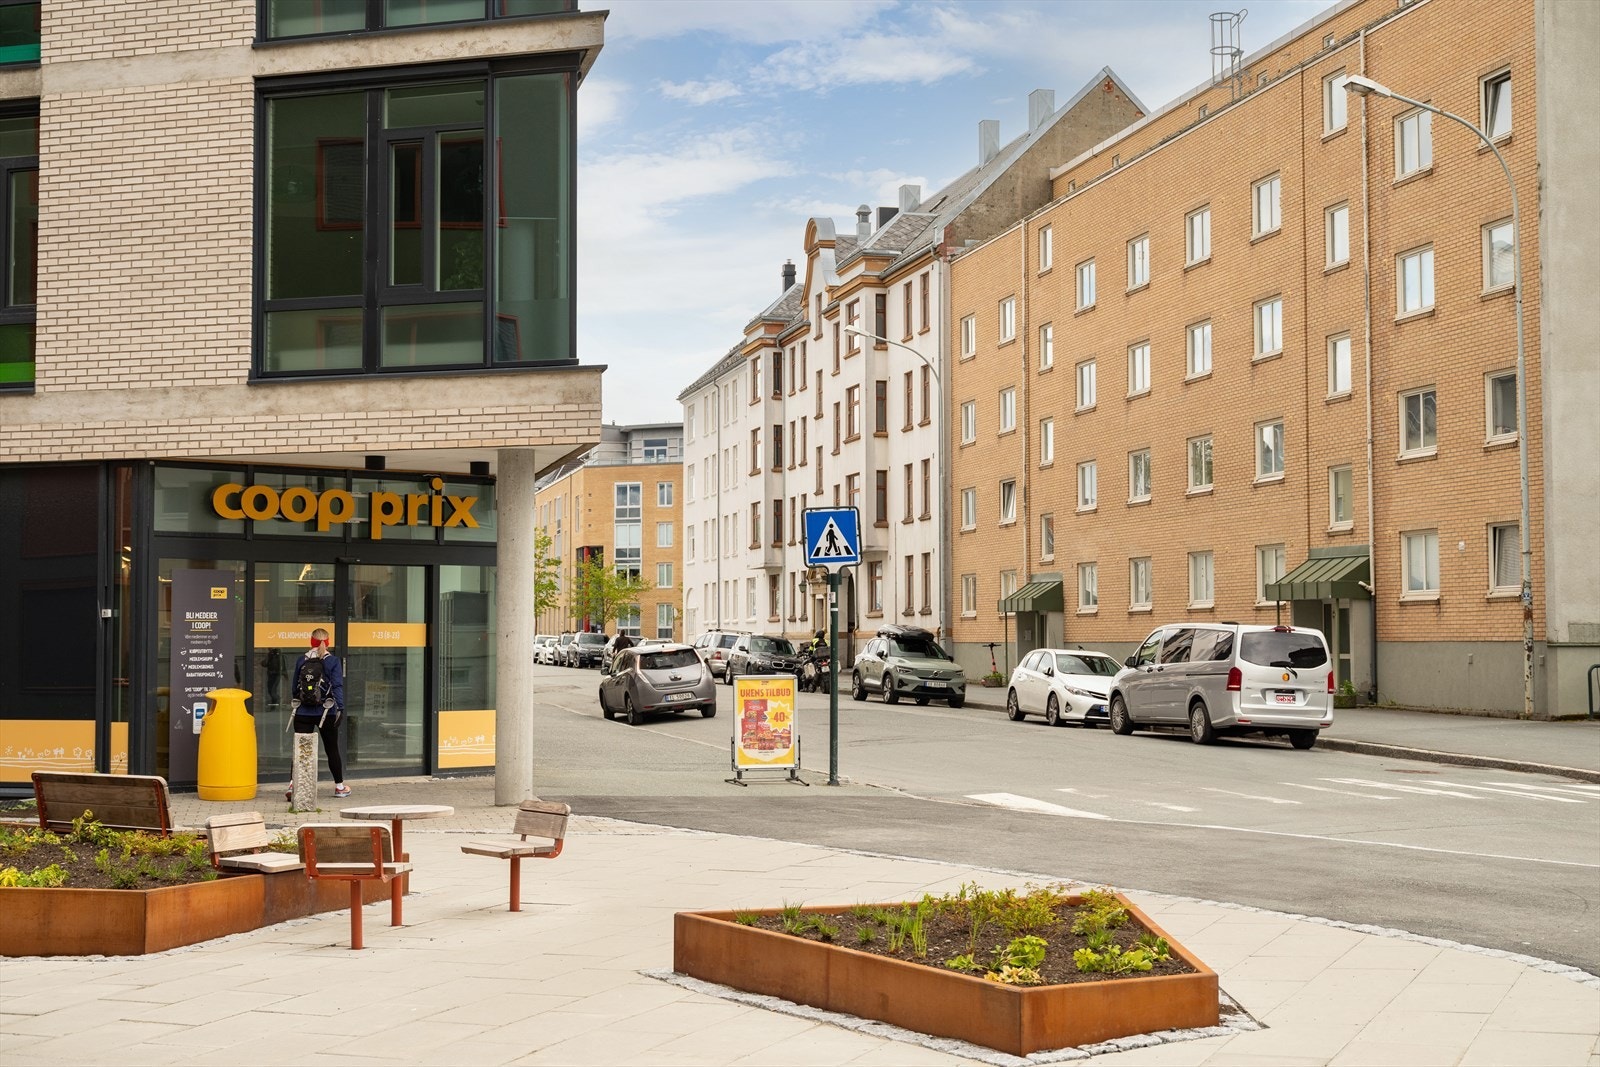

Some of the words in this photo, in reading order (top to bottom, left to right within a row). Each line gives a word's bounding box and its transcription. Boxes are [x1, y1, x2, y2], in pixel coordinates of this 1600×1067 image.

[212, 483, 355, 532] coop
[369, 477, 480, 540] prix
[740, 689, 764, 697] UKENS
[766, 688, 791, 696] TILBUD
